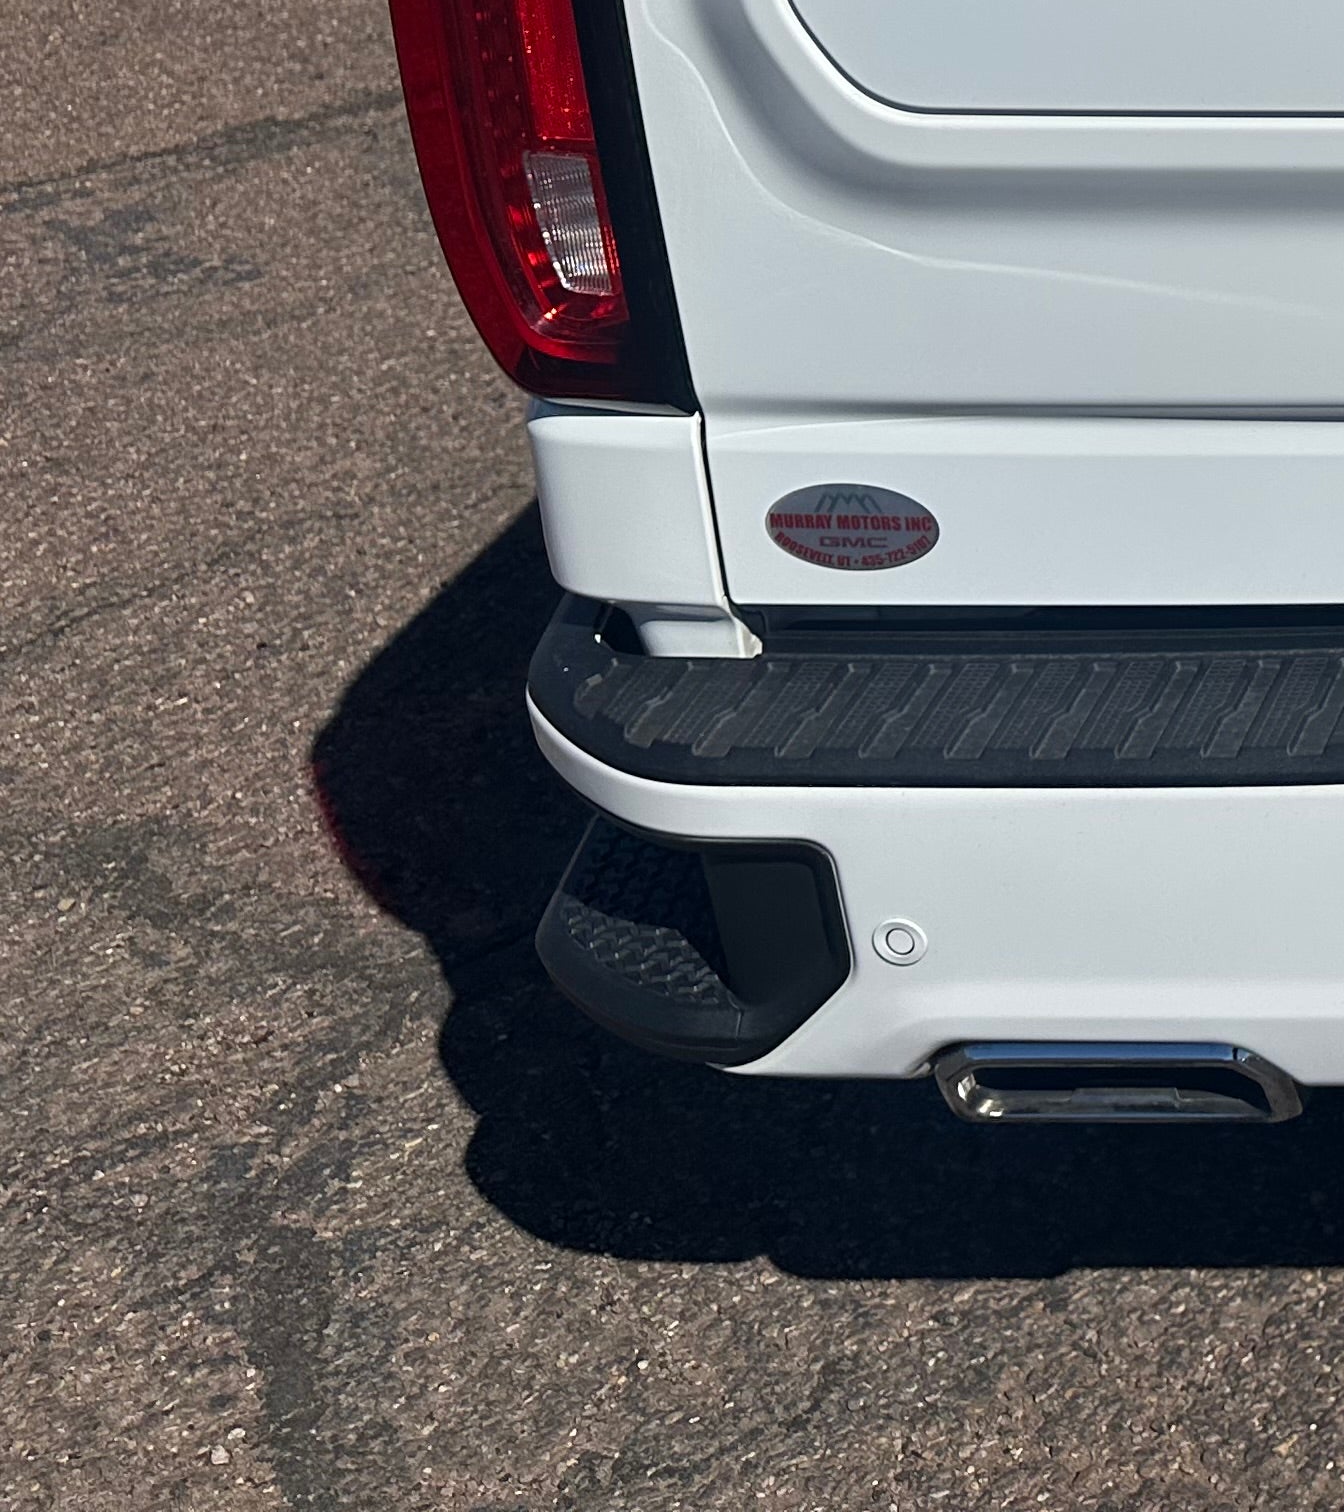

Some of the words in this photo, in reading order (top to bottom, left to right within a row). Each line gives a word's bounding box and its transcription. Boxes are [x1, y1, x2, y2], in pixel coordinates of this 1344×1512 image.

[769, 512, 833, 530] MURRAY
[837, 514, 901, 532] MOTORS
[905, 515, 933, 533] INC
[818, 536, 889, 548] GMC
